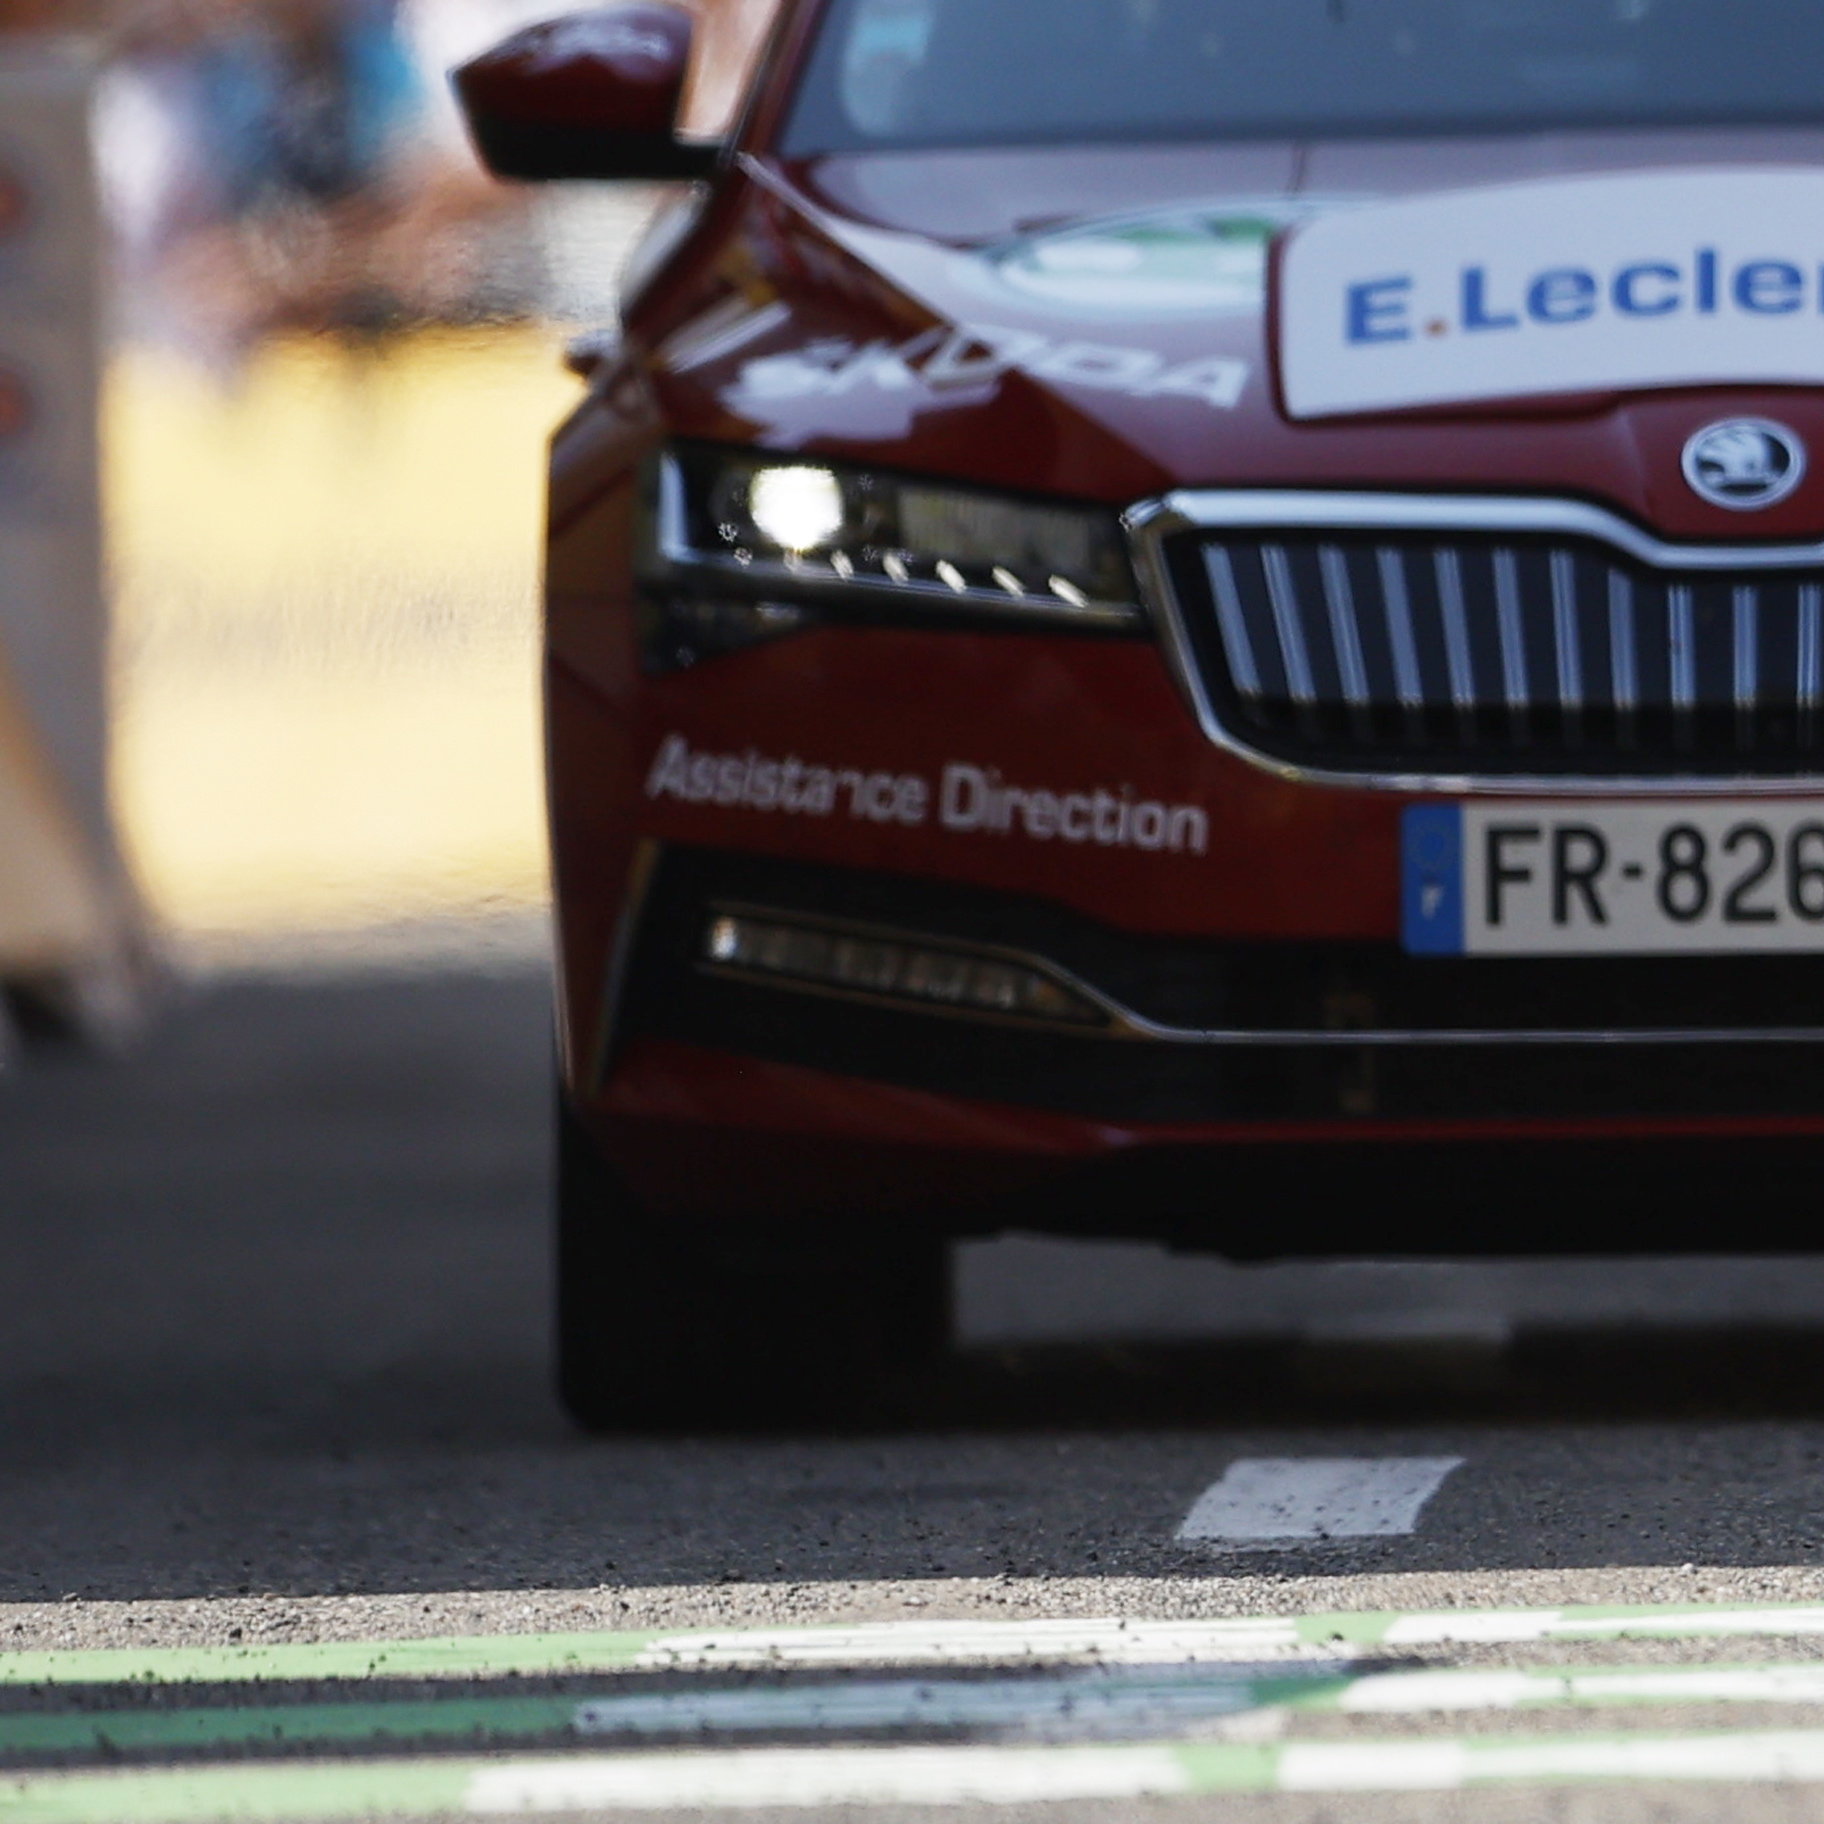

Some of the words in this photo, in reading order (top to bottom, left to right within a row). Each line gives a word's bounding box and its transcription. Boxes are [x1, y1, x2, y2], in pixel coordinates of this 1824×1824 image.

[645, 733, 928, 824] Assistance
[939, 761, 1208, 856] Direction
[1419, 883, 1445, 921] F
